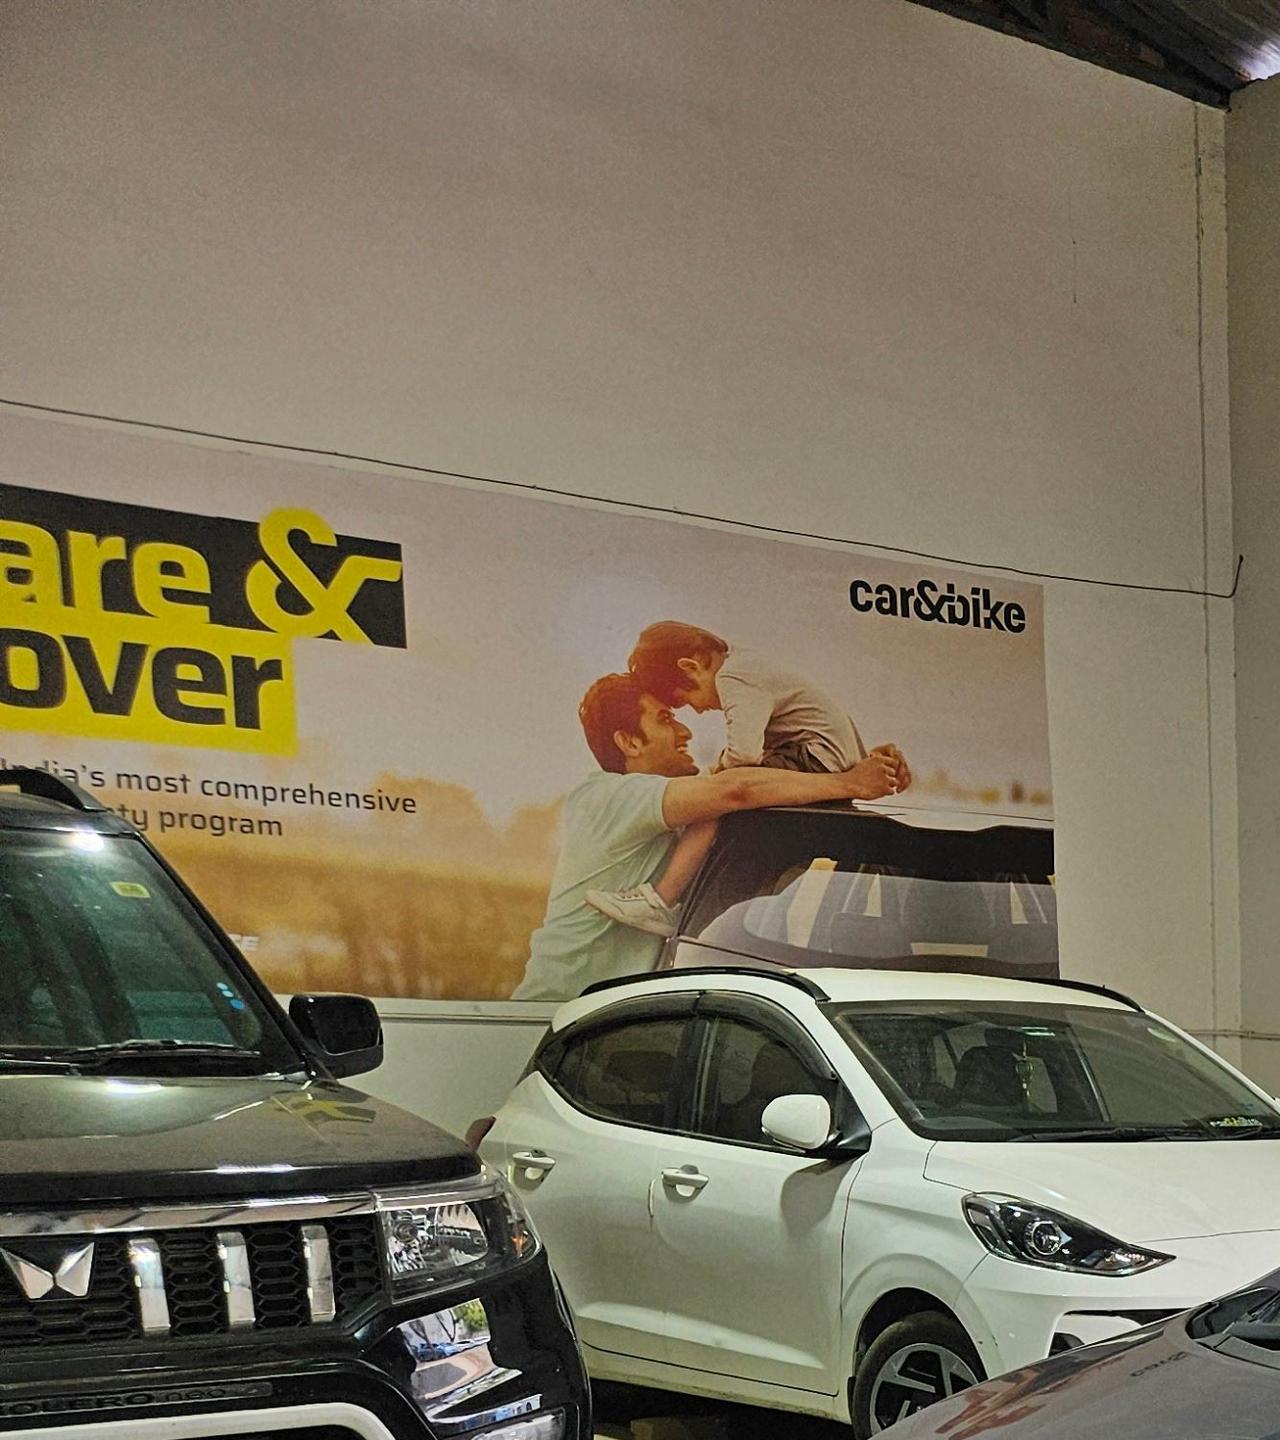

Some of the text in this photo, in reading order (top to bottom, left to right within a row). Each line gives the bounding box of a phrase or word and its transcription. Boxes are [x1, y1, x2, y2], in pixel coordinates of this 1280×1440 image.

[850, 579, 1026, 634] car&bike
[0, 627, 284, 730] over
[116, 772, 191, 794] most
[200, 777, 417, 813] comprehensive
[159, 809, 284, 837] program
